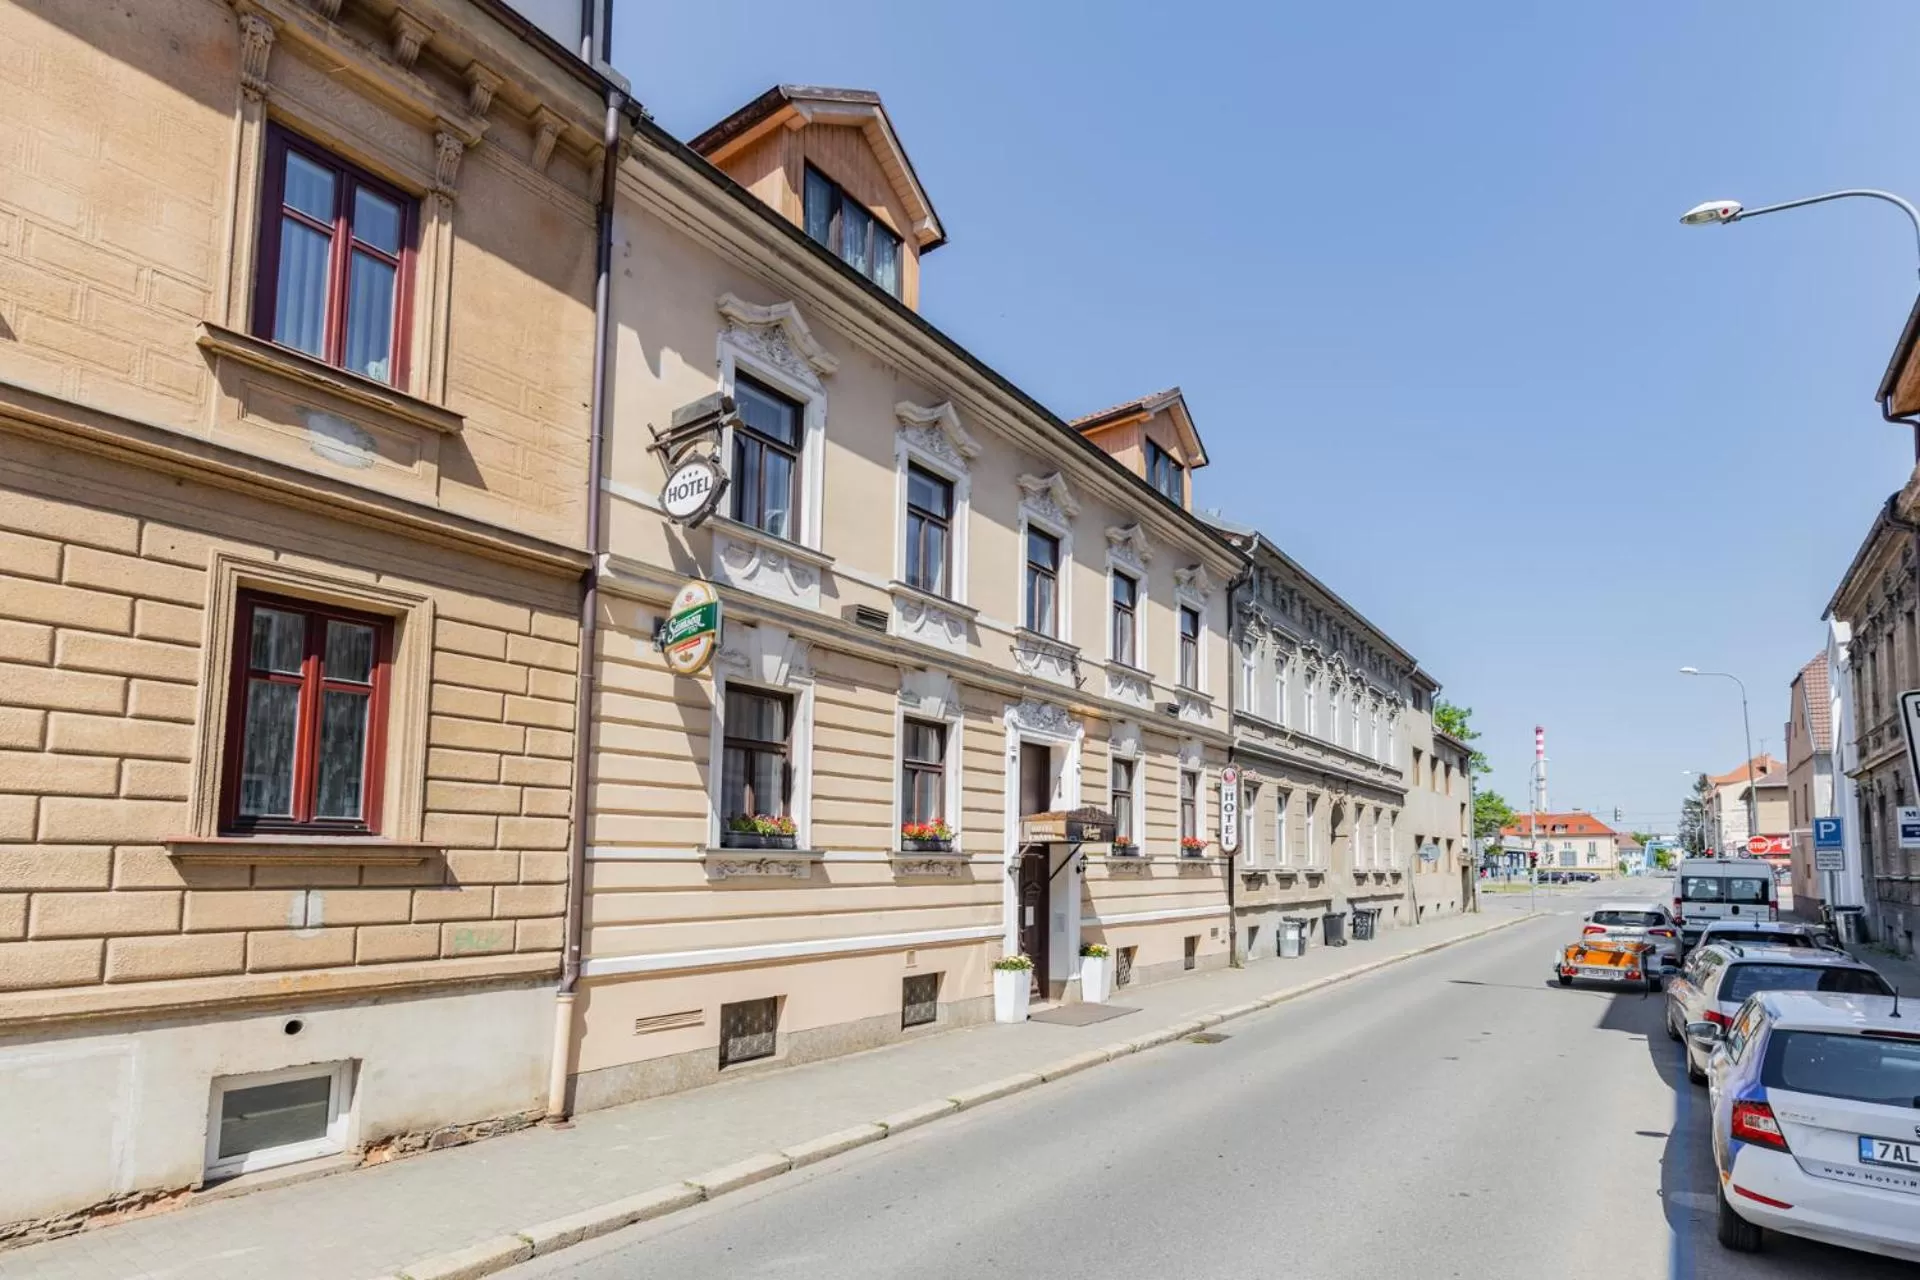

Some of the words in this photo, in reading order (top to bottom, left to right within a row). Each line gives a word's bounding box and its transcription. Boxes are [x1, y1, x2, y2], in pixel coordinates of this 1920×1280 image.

[668, 476, 711, 504] HOTEL
[1224, 791, 1234, 845] HOTEL
[1820, 821, 1837, 839] P
[1749, 841, 1768, 849] STOP
[1878, 1142, 1919, 1164] 7AL
